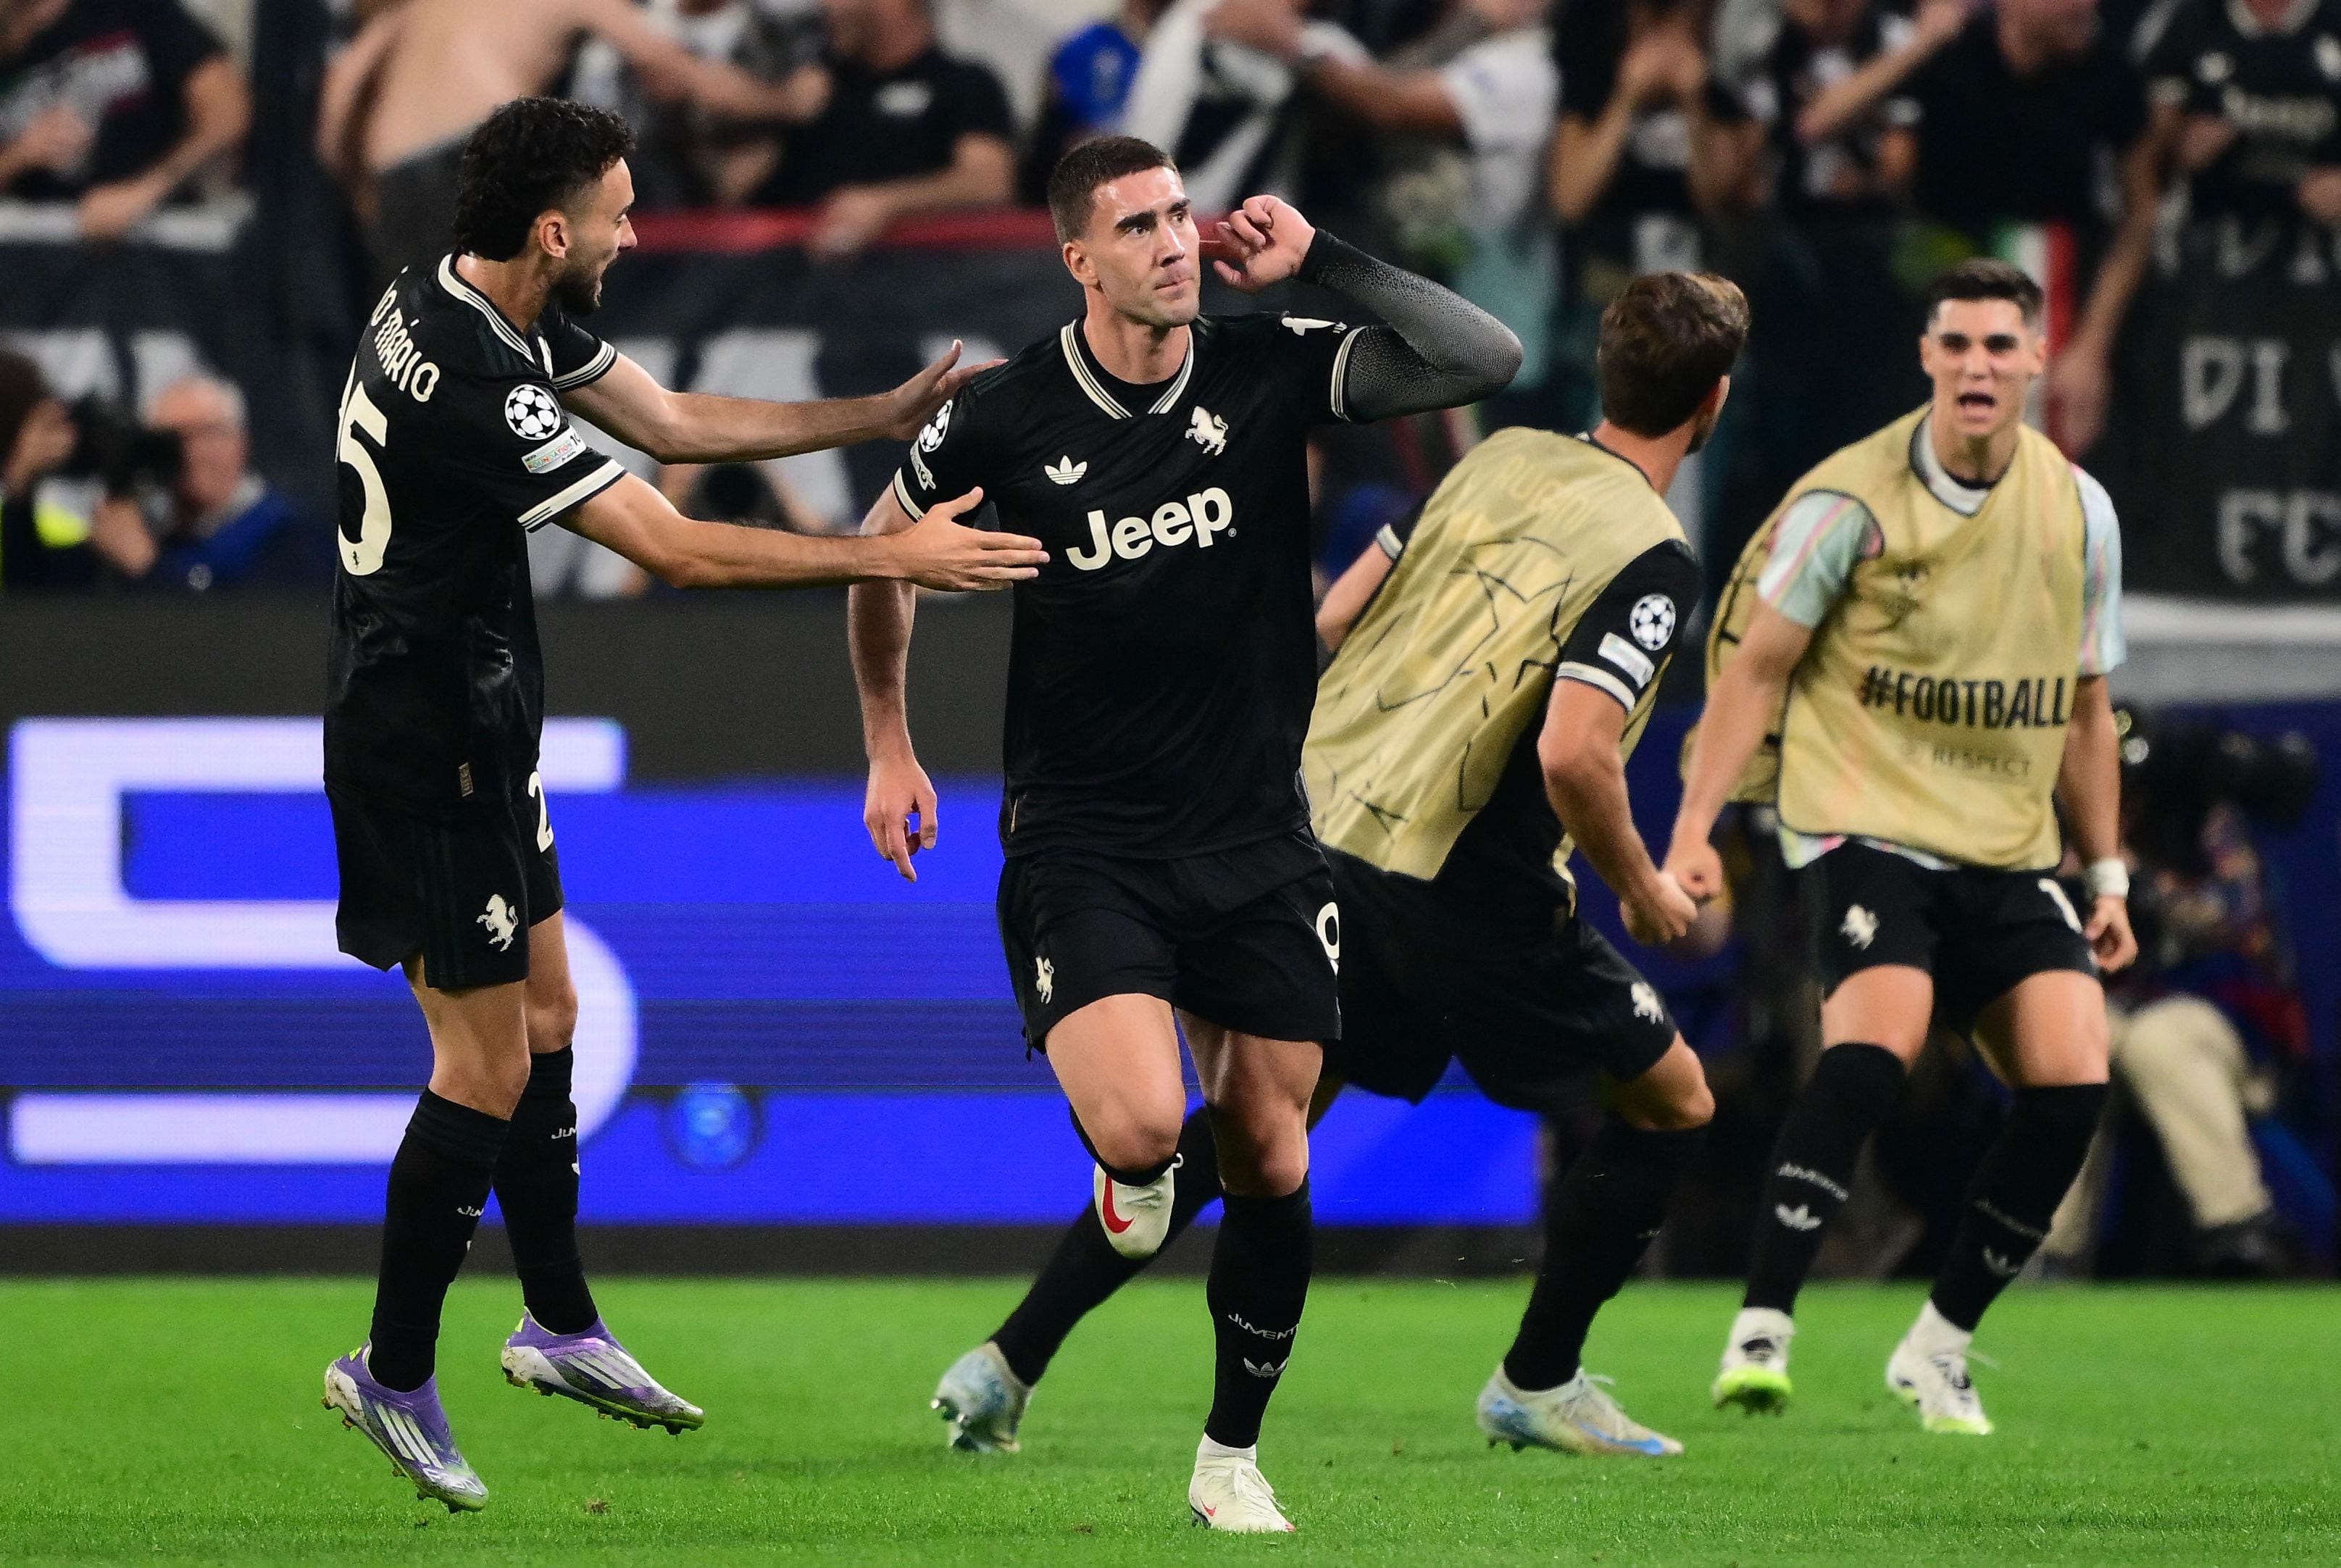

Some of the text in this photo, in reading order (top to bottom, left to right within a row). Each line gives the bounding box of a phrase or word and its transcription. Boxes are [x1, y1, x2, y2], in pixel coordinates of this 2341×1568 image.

[335, 354, 392, 576] 5
[1065, 487, 1232, 571] Jeep
[1861, 666, 2066, 727] #FOOTBALL
